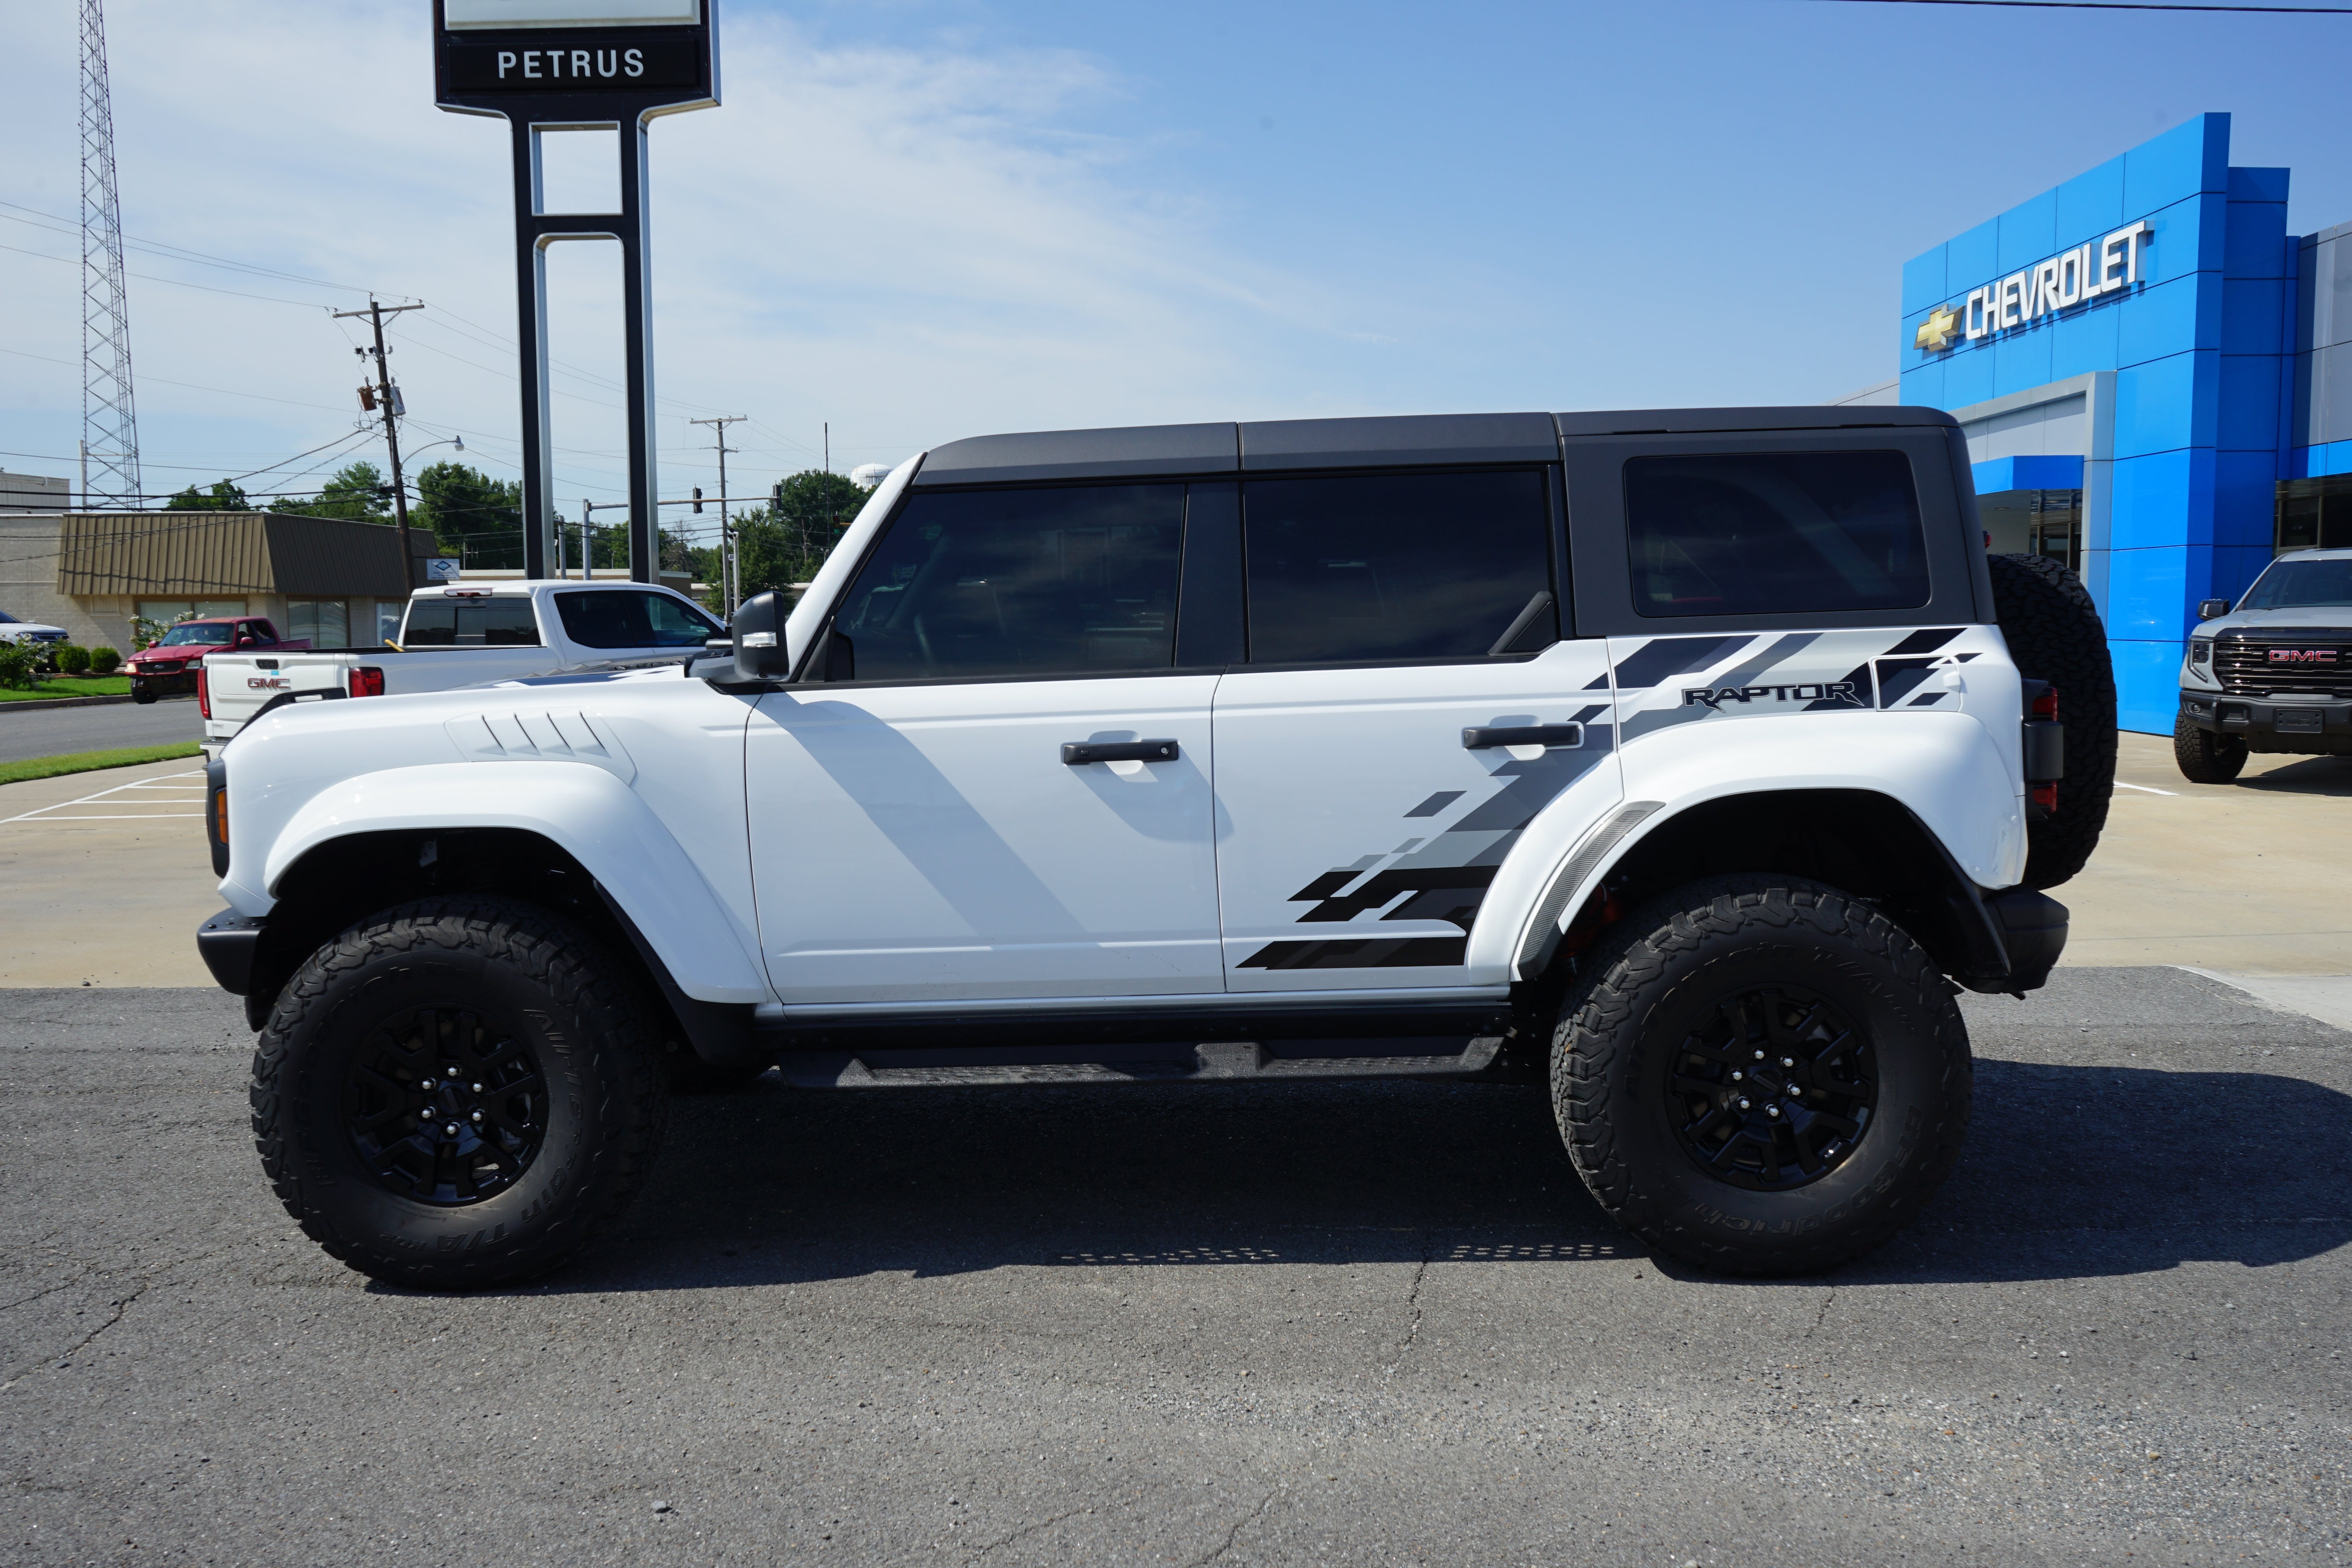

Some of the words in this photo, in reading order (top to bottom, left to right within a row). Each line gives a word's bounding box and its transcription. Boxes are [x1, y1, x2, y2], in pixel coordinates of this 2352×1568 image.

[497, 48, 644, 79] PETRUS
[1965, 220, 2148, 341] CHEVROLET
[2268, 650, 2337, 662] GMC
[247, 677, 290, 689] GMC
[1681, 681, 1865, 713] RAPTOR
[1694, 1103, 1926, 1238] BFGoodrich
[436, 1222, 512, 1254] T/A
